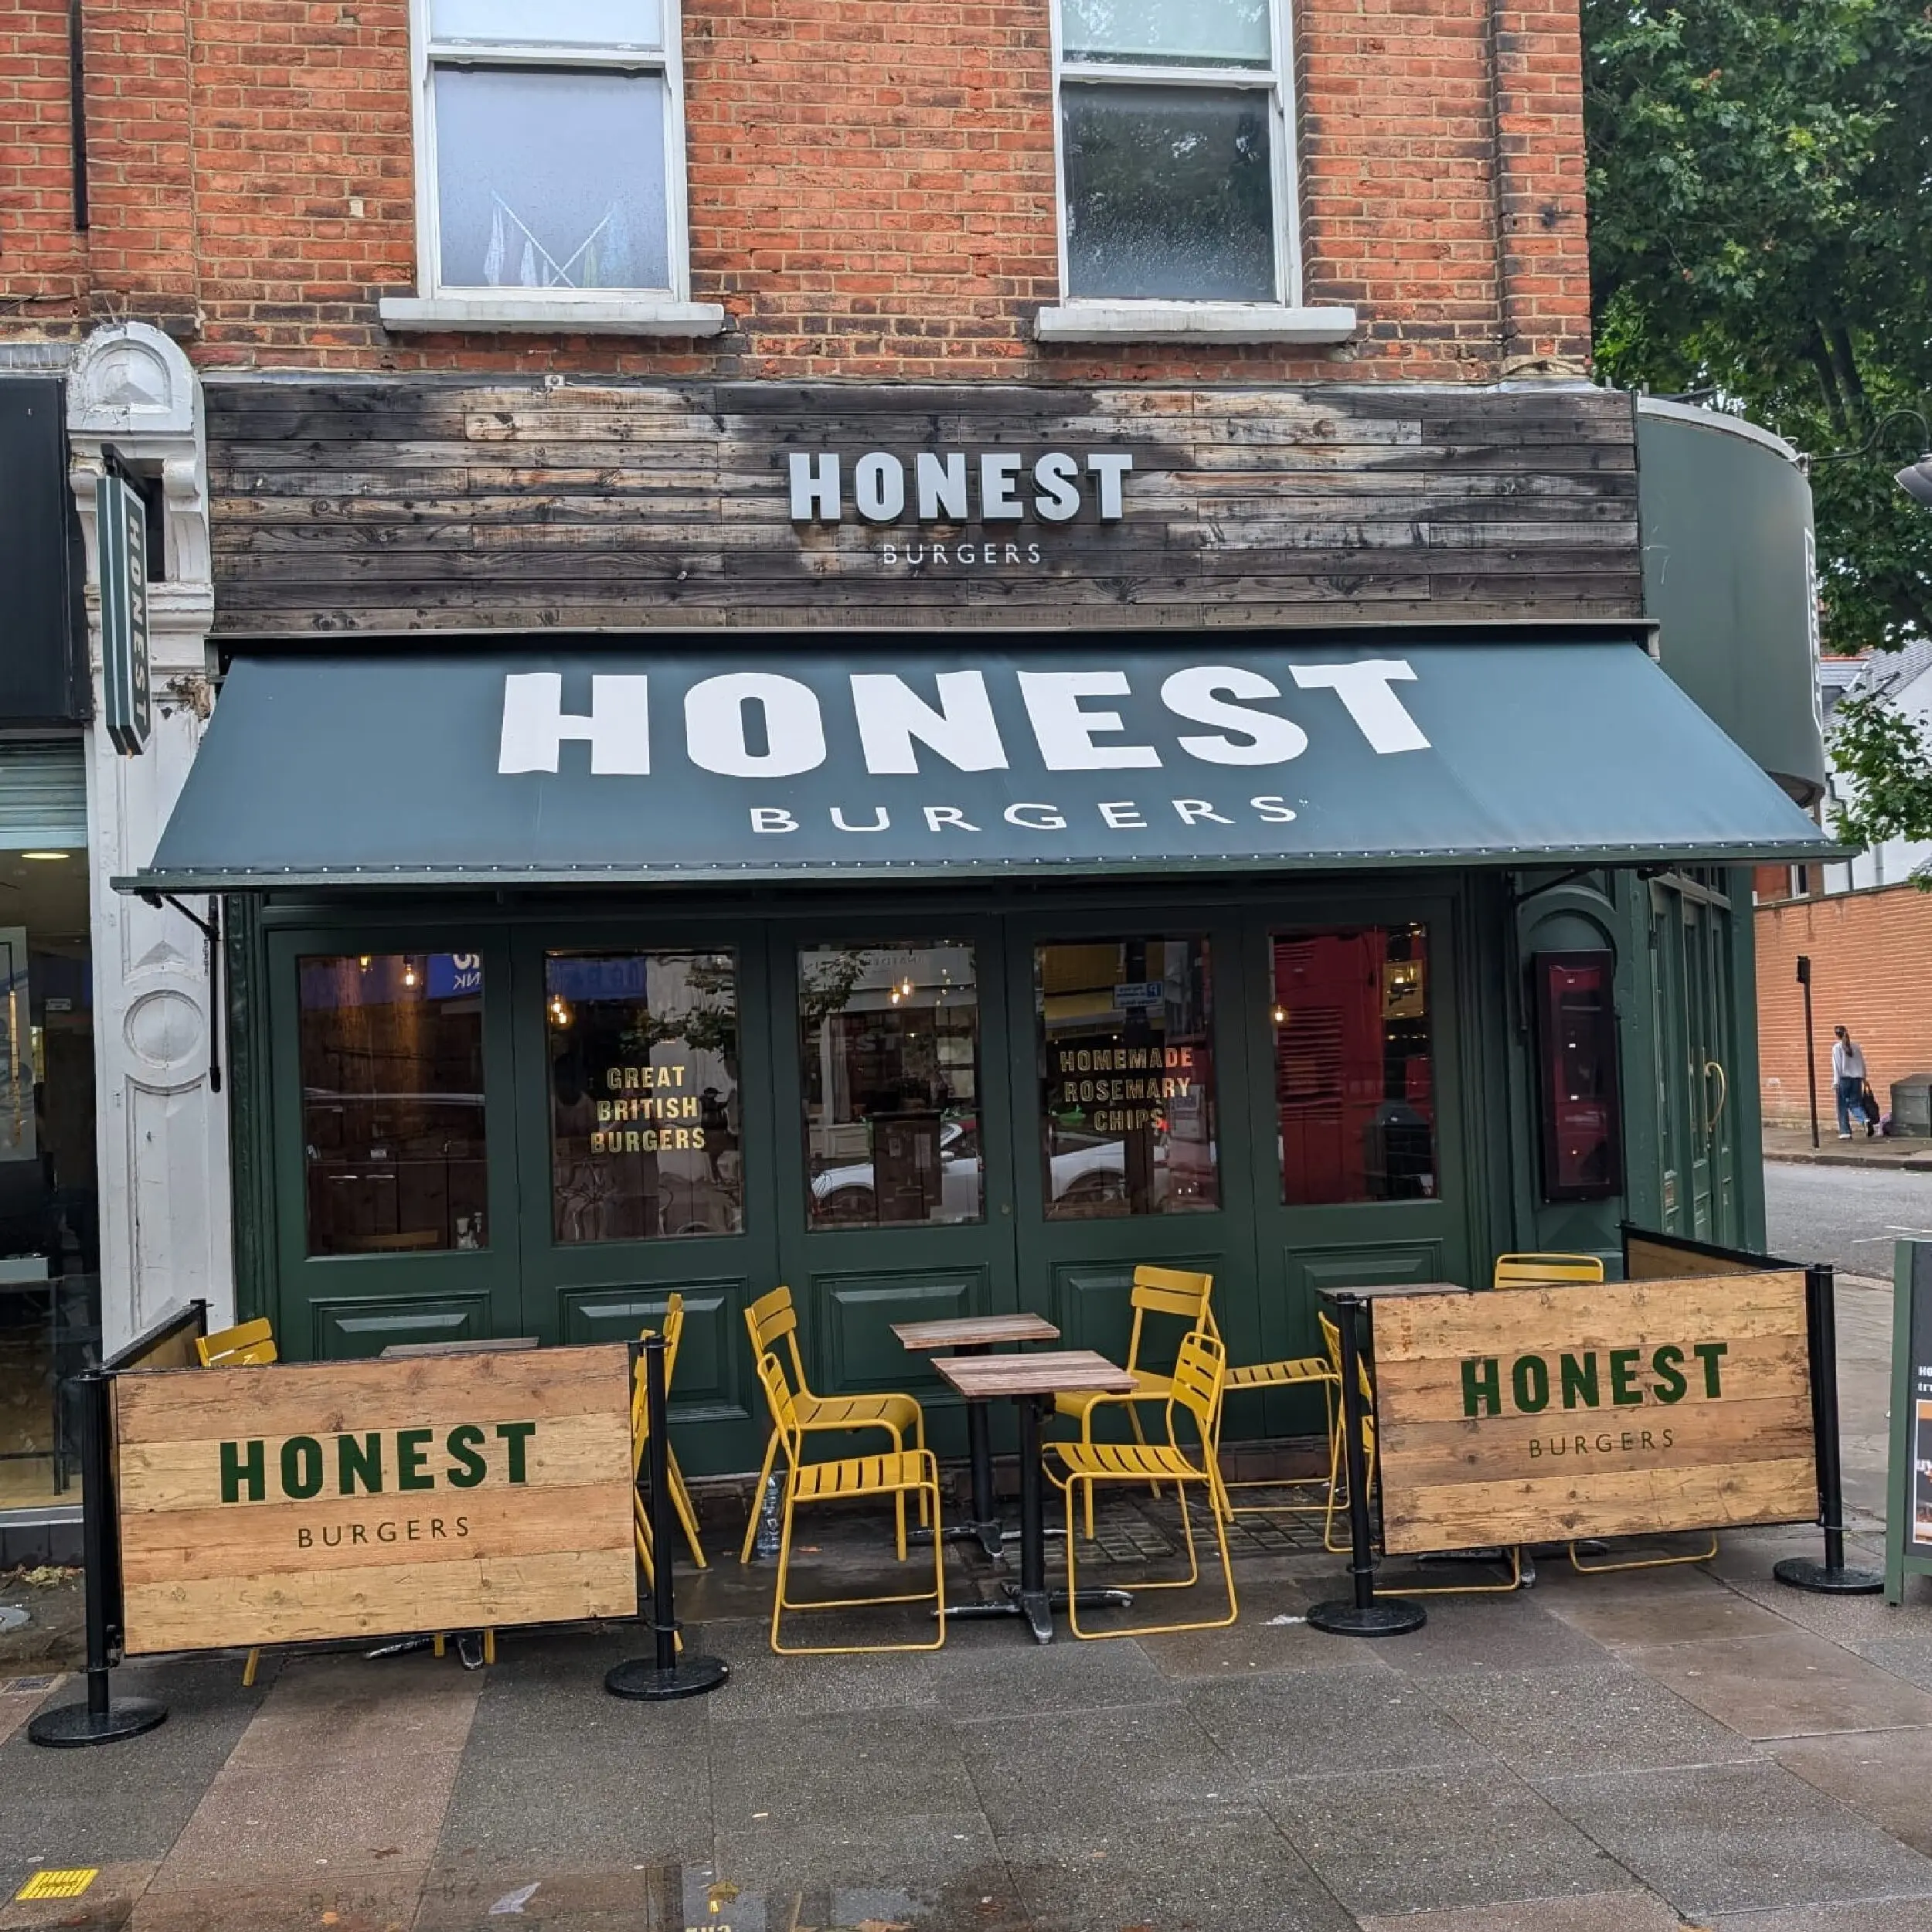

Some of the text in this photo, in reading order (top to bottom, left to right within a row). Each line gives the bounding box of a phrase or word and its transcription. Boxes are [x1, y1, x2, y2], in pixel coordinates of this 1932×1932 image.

[789, 452, 1134, 521] HONEST
[882, 543, 1041, 565] BURGERS
[129, 514, 147, 726] HONEST
[498, 658, 1432, 777] HONEST
[750, 796, 1298, 833] BURGERS
[1060, 1047, 1194, 1072] HOMEMADE
[607, 1066, 685, 1090] GREAT
[1064, 1077, 1191, 1102] ROSEMARY
[597, 1097, 698, 1121] BRITISH
[1094, 1108, 1163, 1131] CHIPS
[590, 1128, 706, 1154] BURGERS
[1461, 1343, 1728, 1417] HONEST
[1528, 1428, 1675, 1459] BURGERS
[220, 1422, 536, 1503] HONEST
[298, 1516, 469, 1548] BURGERS
